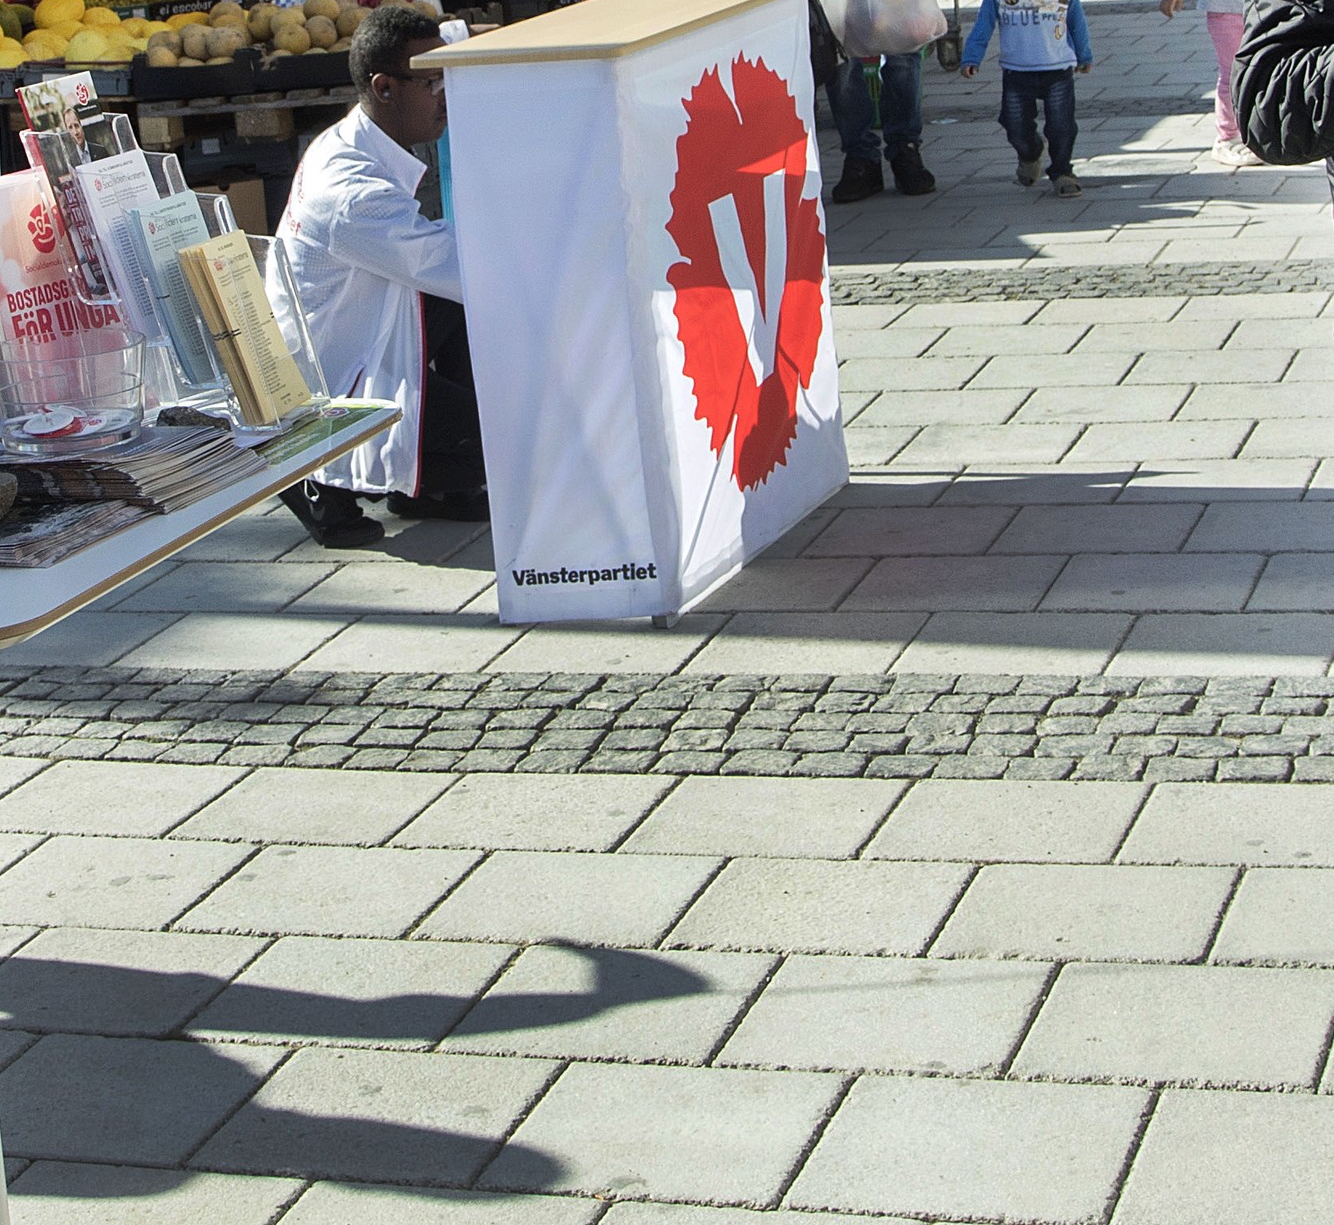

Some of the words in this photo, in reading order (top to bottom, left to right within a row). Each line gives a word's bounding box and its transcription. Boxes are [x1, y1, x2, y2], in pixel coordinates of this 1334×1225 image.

[1002, 8, 1041, 27] BLUE
[707, 168, 787, 387] V
[11, 307, 56, 340] FÖR
[511, 562, 657, 587] Vänsterpartiet
